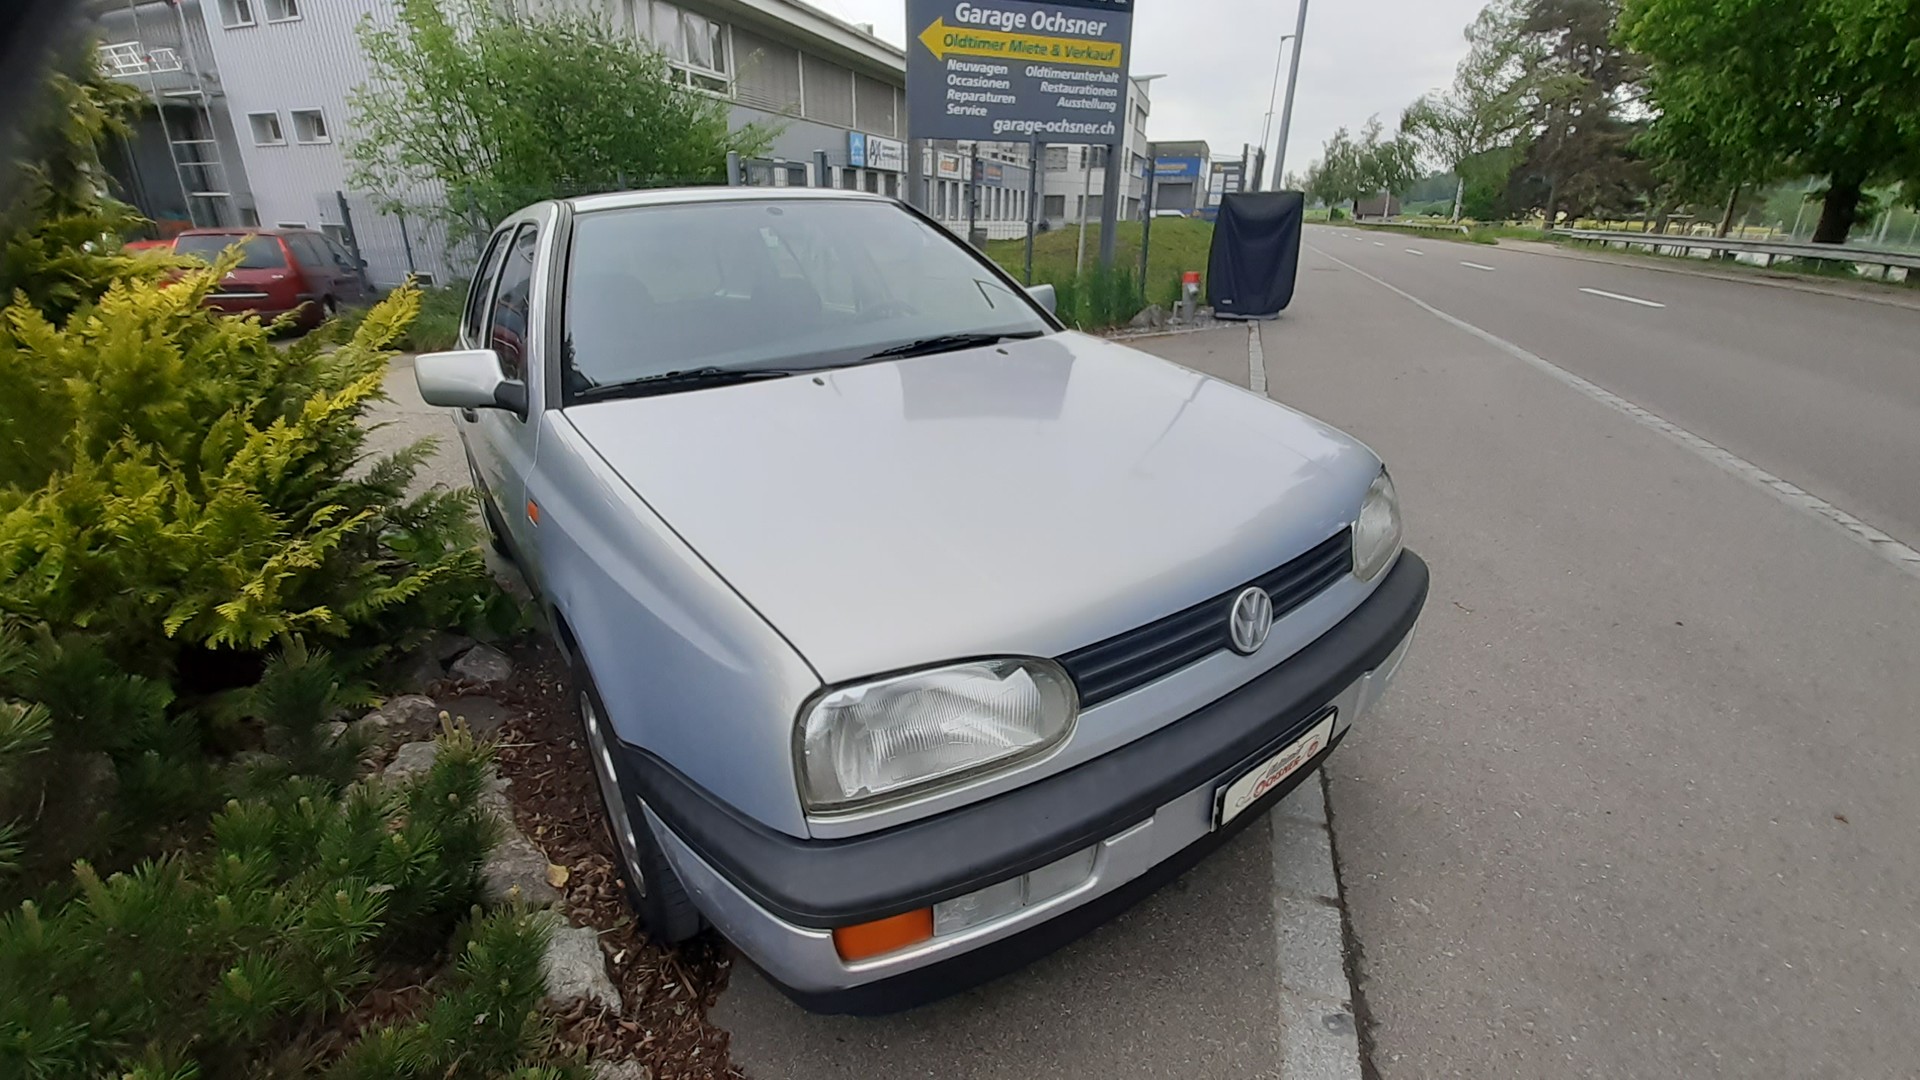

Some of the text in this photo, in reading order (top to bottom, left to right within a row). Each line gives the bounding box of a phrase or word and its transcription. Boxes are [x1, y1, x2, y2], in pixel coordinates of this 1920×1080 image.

[955, 2, 1107, 36] Garage Ochsner
[943, 33, 1115, 61] Oldtimer Miete & Verkauf
[947, 59, 1008, 76] Neuwagen
[1025, 65, 1120, 83] Oldtimerunterhalt
[947, 74, 1010, 90] Occasionen
[1040, 81, 1118, 97] Restaurationen
[947, 89, 1016, 105] Reparaturen
[1056, 96, 1117, 113] Ausstellung
[946, 103, 988, 117] Service
[993, 117, 1116, 136] garage-ochsner.ch
